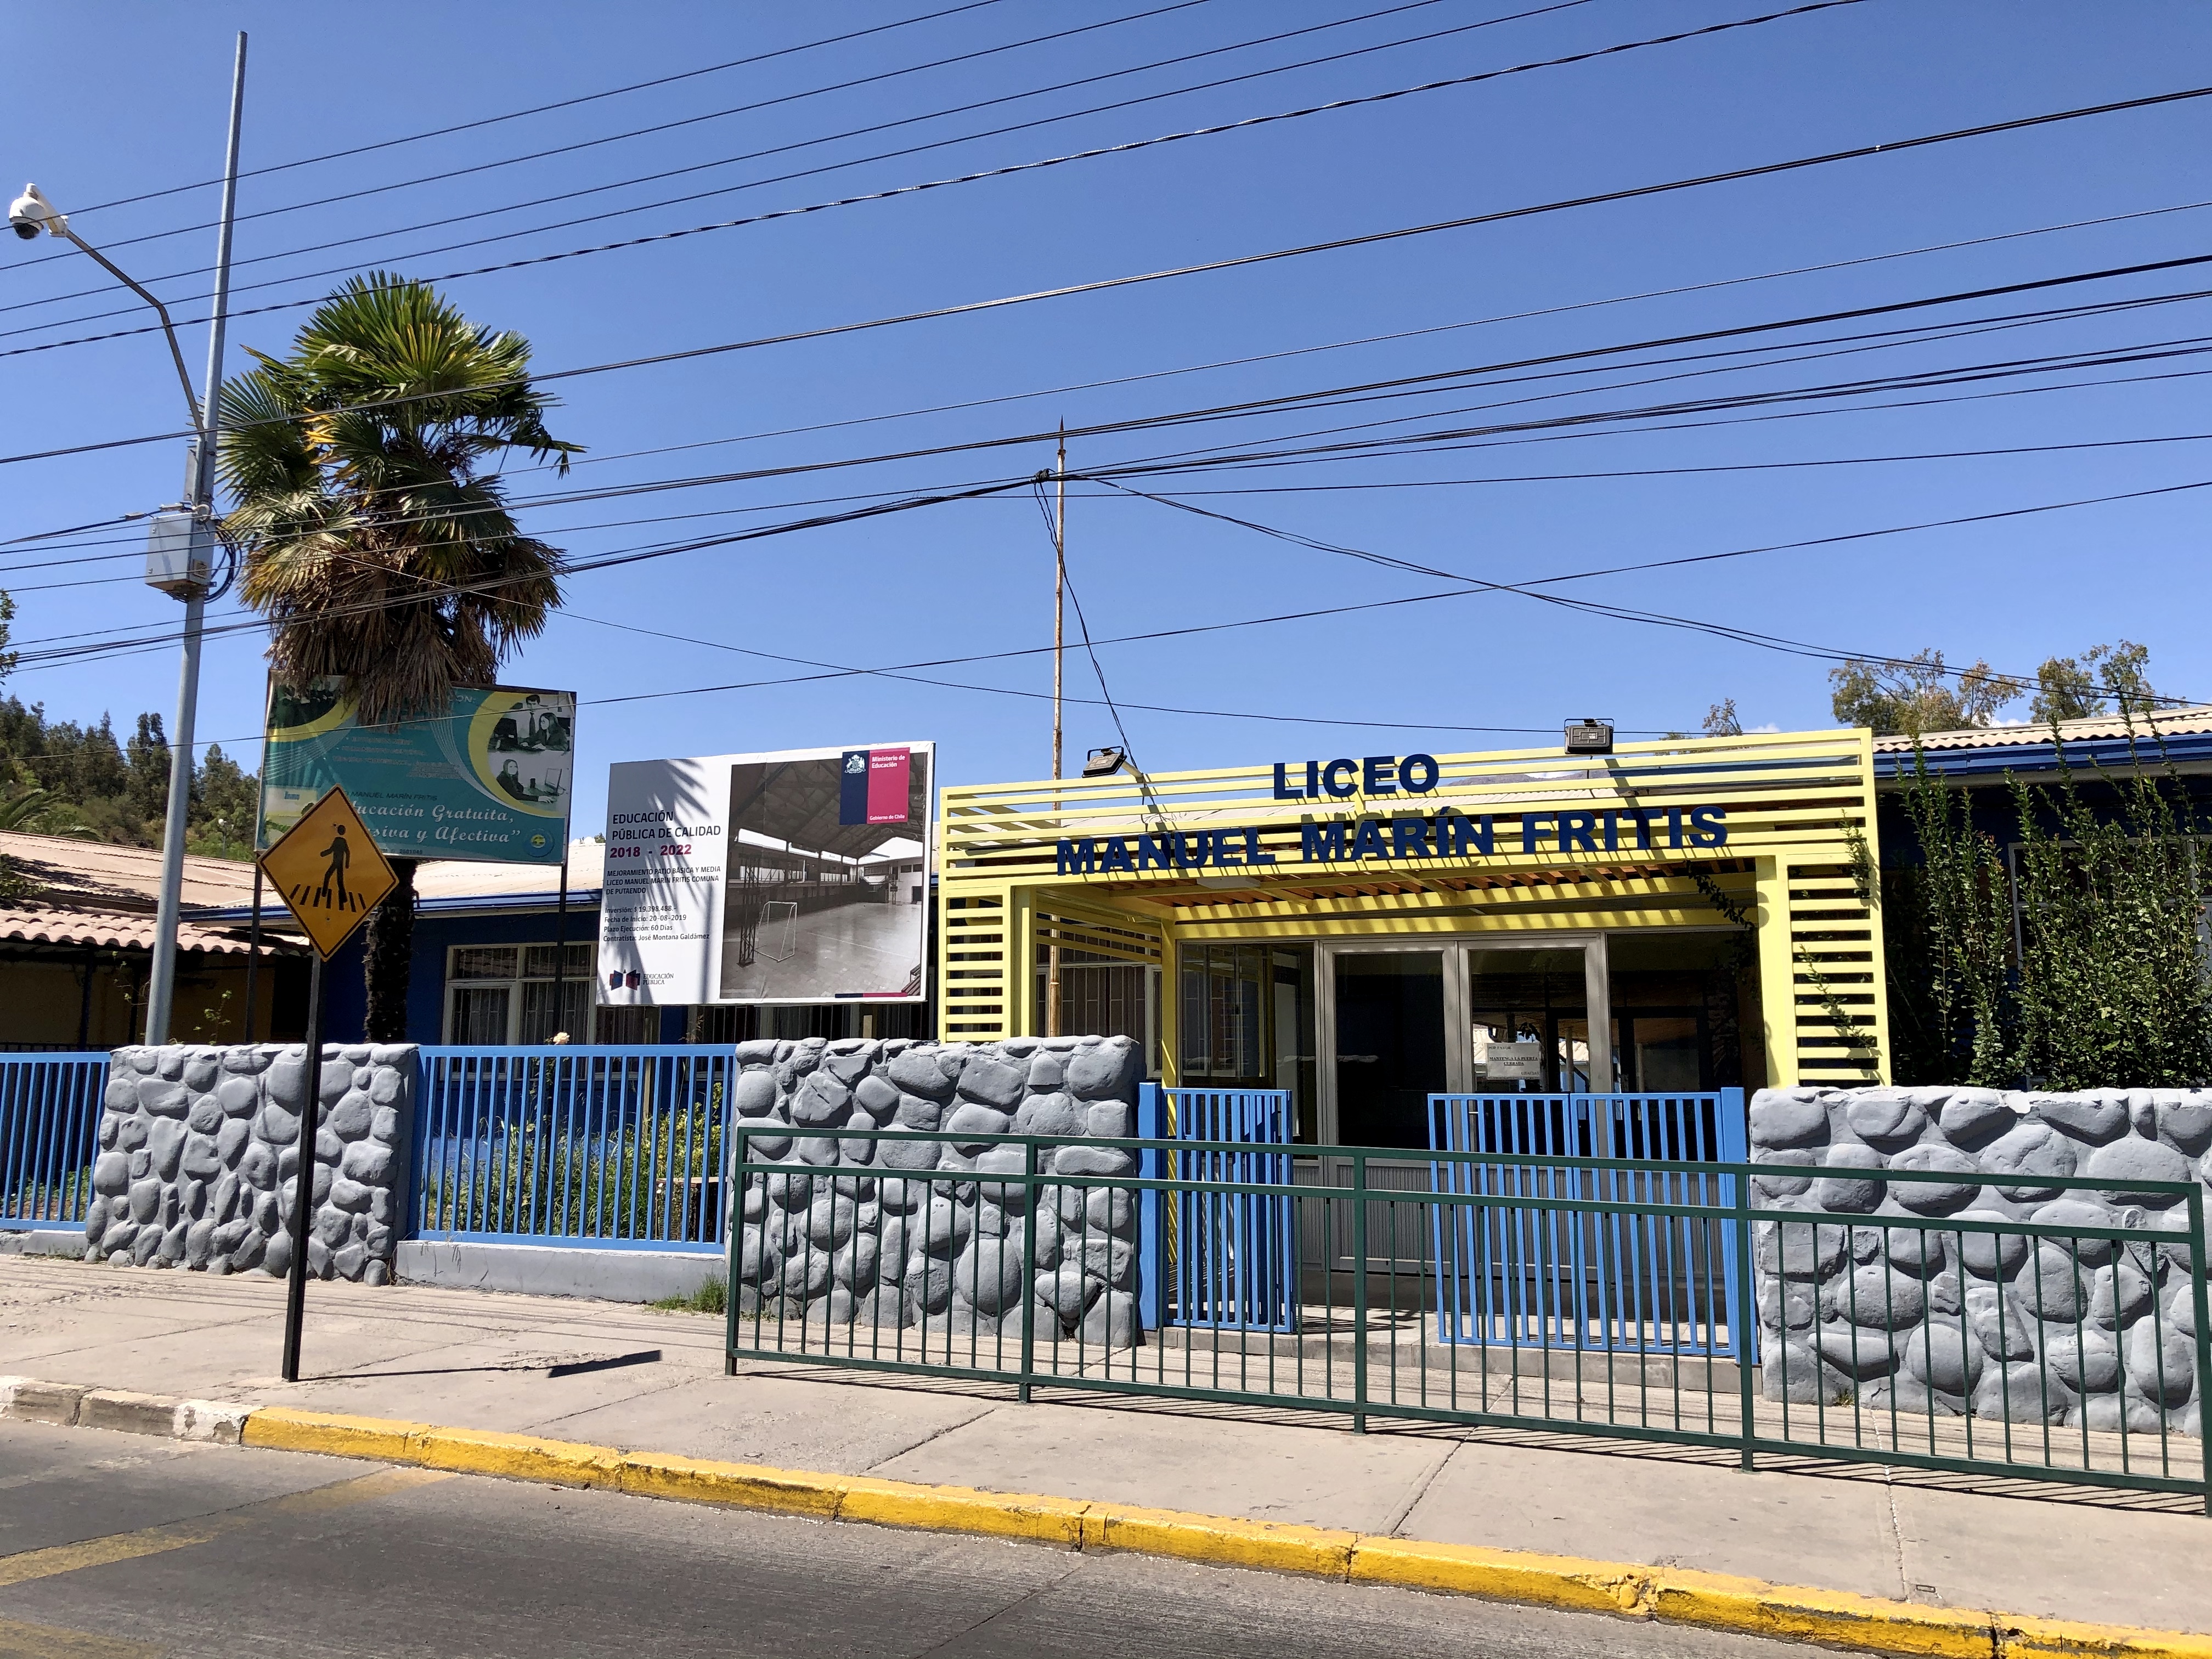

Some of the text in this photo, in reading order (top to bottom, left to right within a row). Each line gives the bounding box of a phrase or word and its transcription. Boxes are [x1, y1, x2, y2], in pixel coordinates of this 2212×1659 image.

[1274, 754, 1439, 800] LICEO
[432, 805, 514, 823] Gratuita,
[613, 810, 674, 824] EDUCACIÓN
[416, 829, 427, 843] y
[612, 826, 721, 840] PÚBLICA DE CALIDAD
[1057, 805, 1728, 876] MANUEL MARÍN FRITIS
[610, 847, 641, 858] 2018
[660, 844, 692, 856] 2022
[607, 868, 653, 877] MEJORAMIENTO
